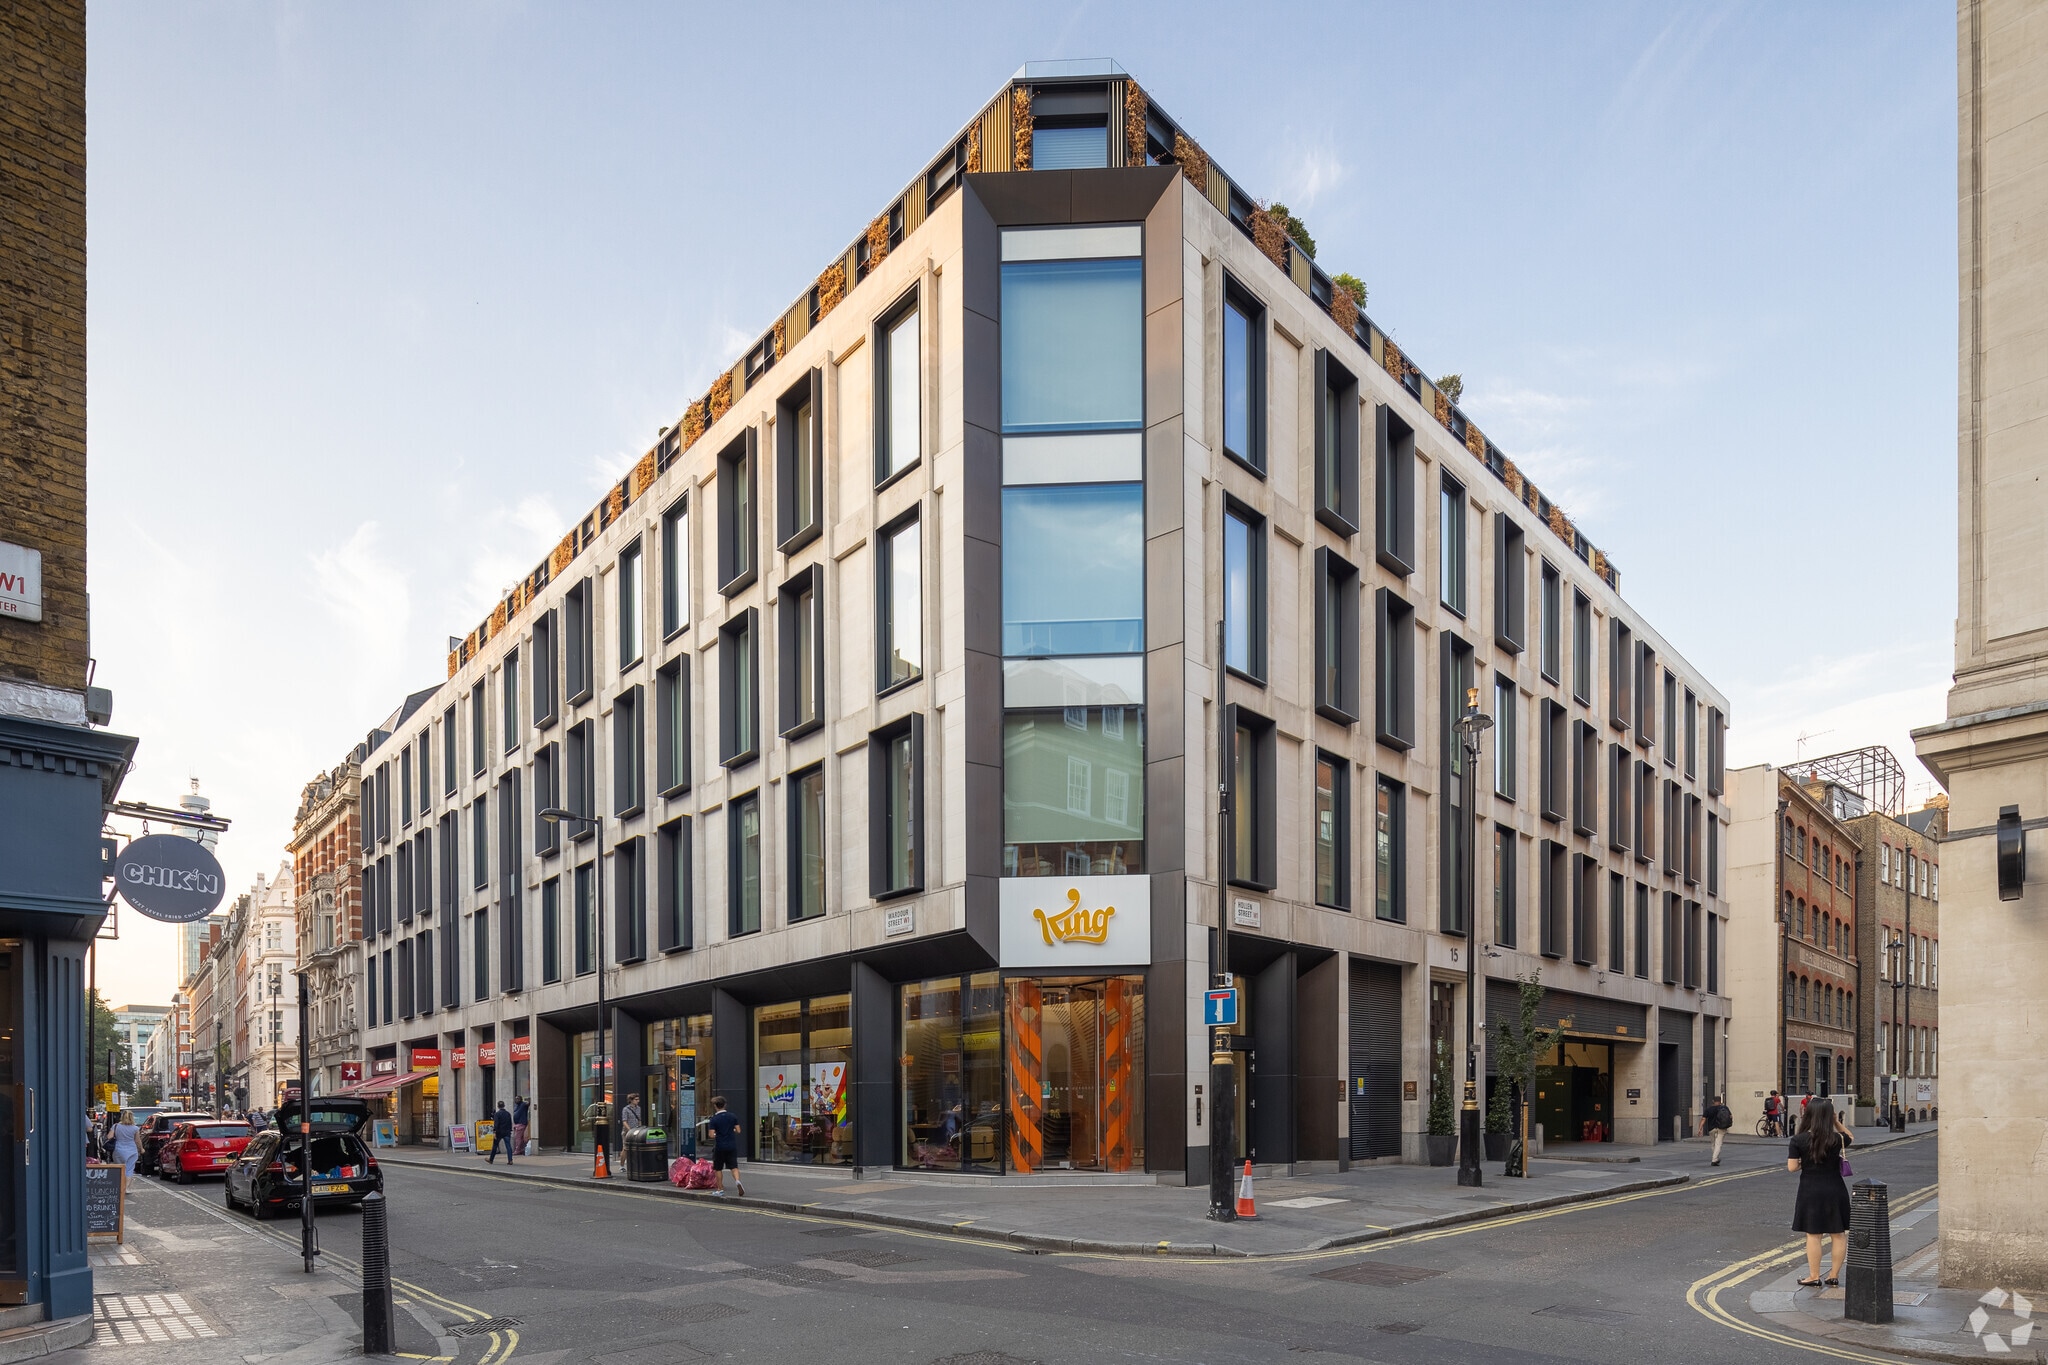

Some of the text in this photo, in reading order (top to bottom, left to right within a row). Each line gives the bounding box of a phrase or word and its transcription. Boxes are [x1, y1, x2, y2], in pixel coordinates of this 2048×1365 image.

[131, 897, 145, 909] NEXT
[145, 907, 163, 918] LEVEL
[183, 907, 208, 919] CHICKEN
[1238, 901, 1253, 911] HOLLEN
[888, 908, 909, 920] WARDOUR
[1032, 888, 1116, 946] King
[1238, 909, 1252, 918] STREET
[887, 916, 910, 928] STREET W1
[1450, 947, 1459, 963] 15
